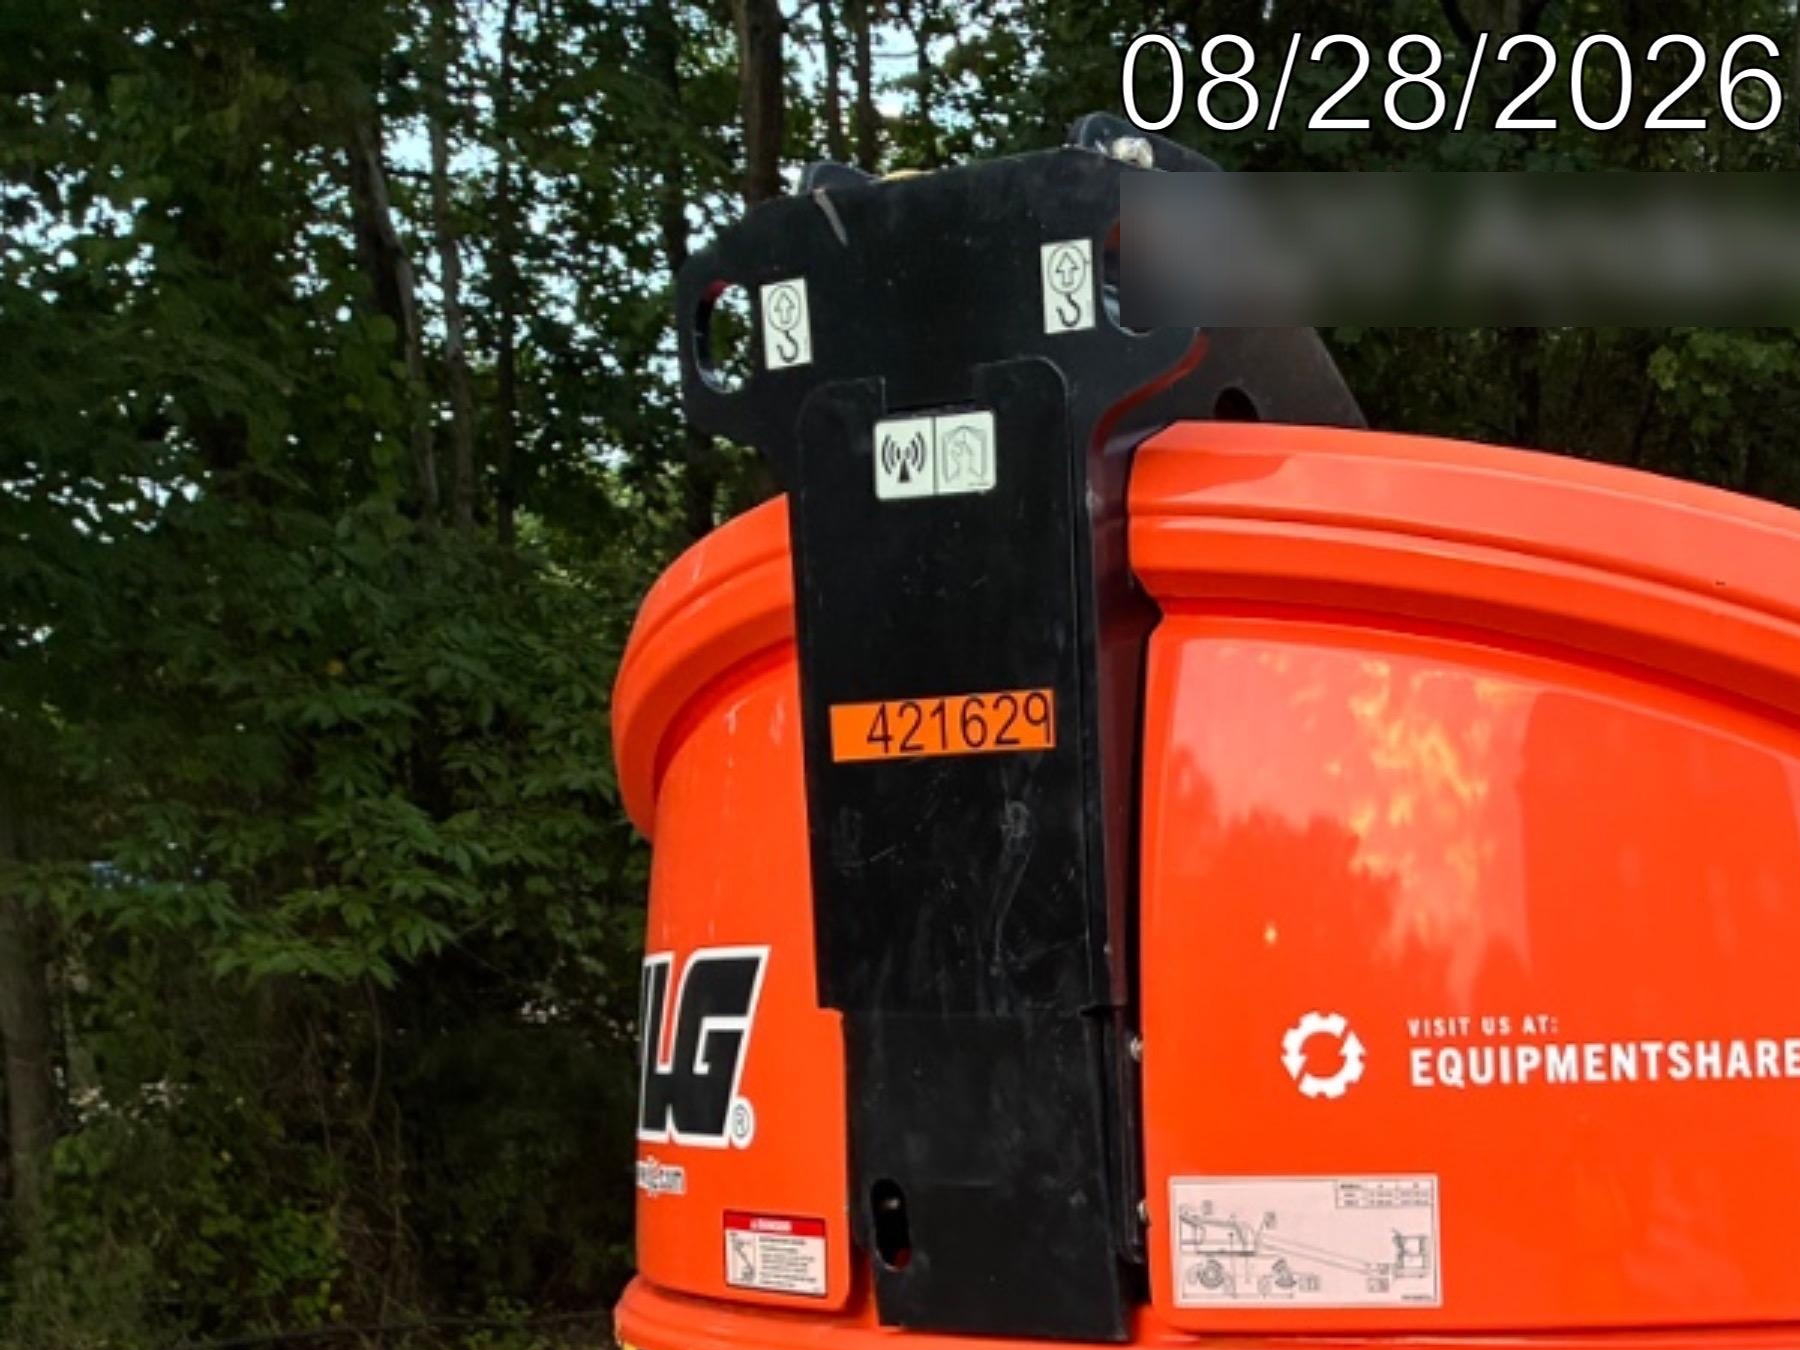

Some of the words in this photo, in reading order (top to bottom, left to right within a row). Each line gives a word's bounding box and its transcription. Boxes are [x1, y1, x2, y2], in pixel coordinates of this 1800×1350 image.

[867, 692, 1052, 752] 421629
[1408, 1017, 1470, 1038] VISIT
[1481, 1016, 1511, 1036] US
[1522, 1014, 1560, 1036] AT:
